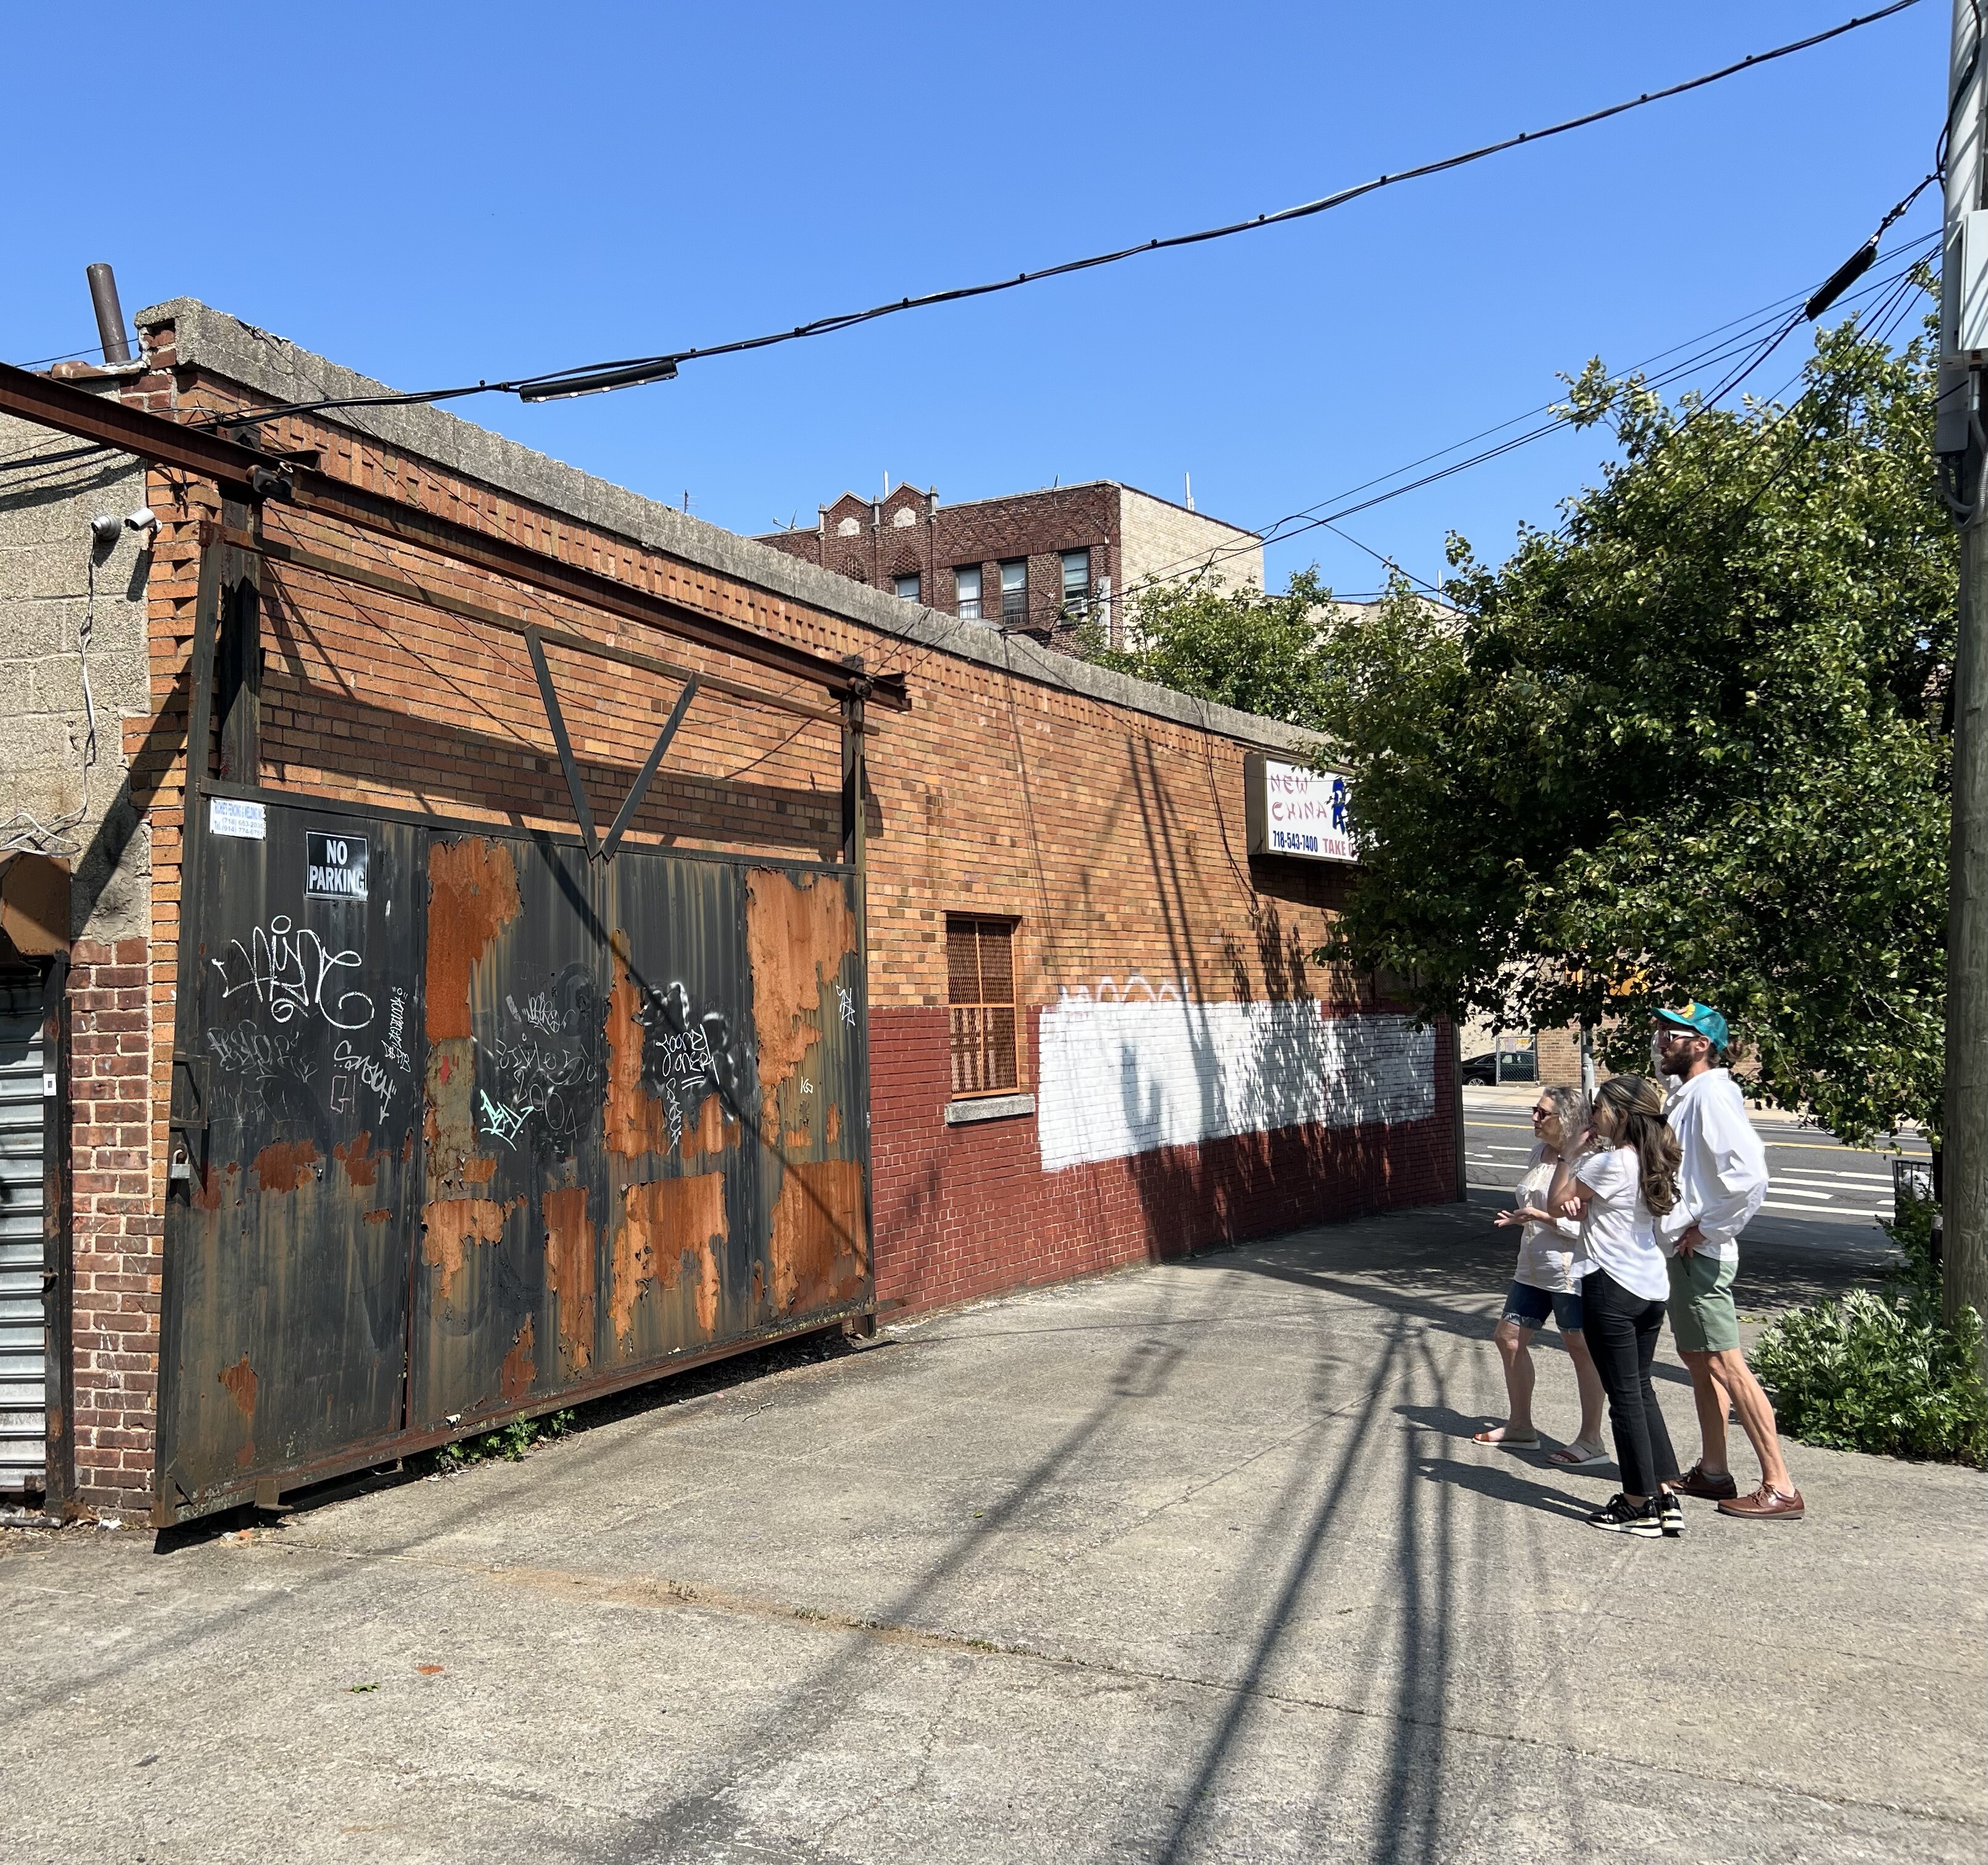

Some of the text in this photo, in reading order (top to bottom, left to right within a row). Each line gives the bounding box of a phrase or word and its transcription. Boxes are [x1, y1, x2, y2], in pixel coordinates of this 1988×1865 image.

[1270, 774, 1308, 794] NEW
[1272, 801, 1327, 821] CHINA
[326, 839, 348, 865] NO
[1273, 830, 1318, 852] 718-543-7400
[1322, 838, 1347, 856] TAKE
[309, 865, 365, 892] PARKING
